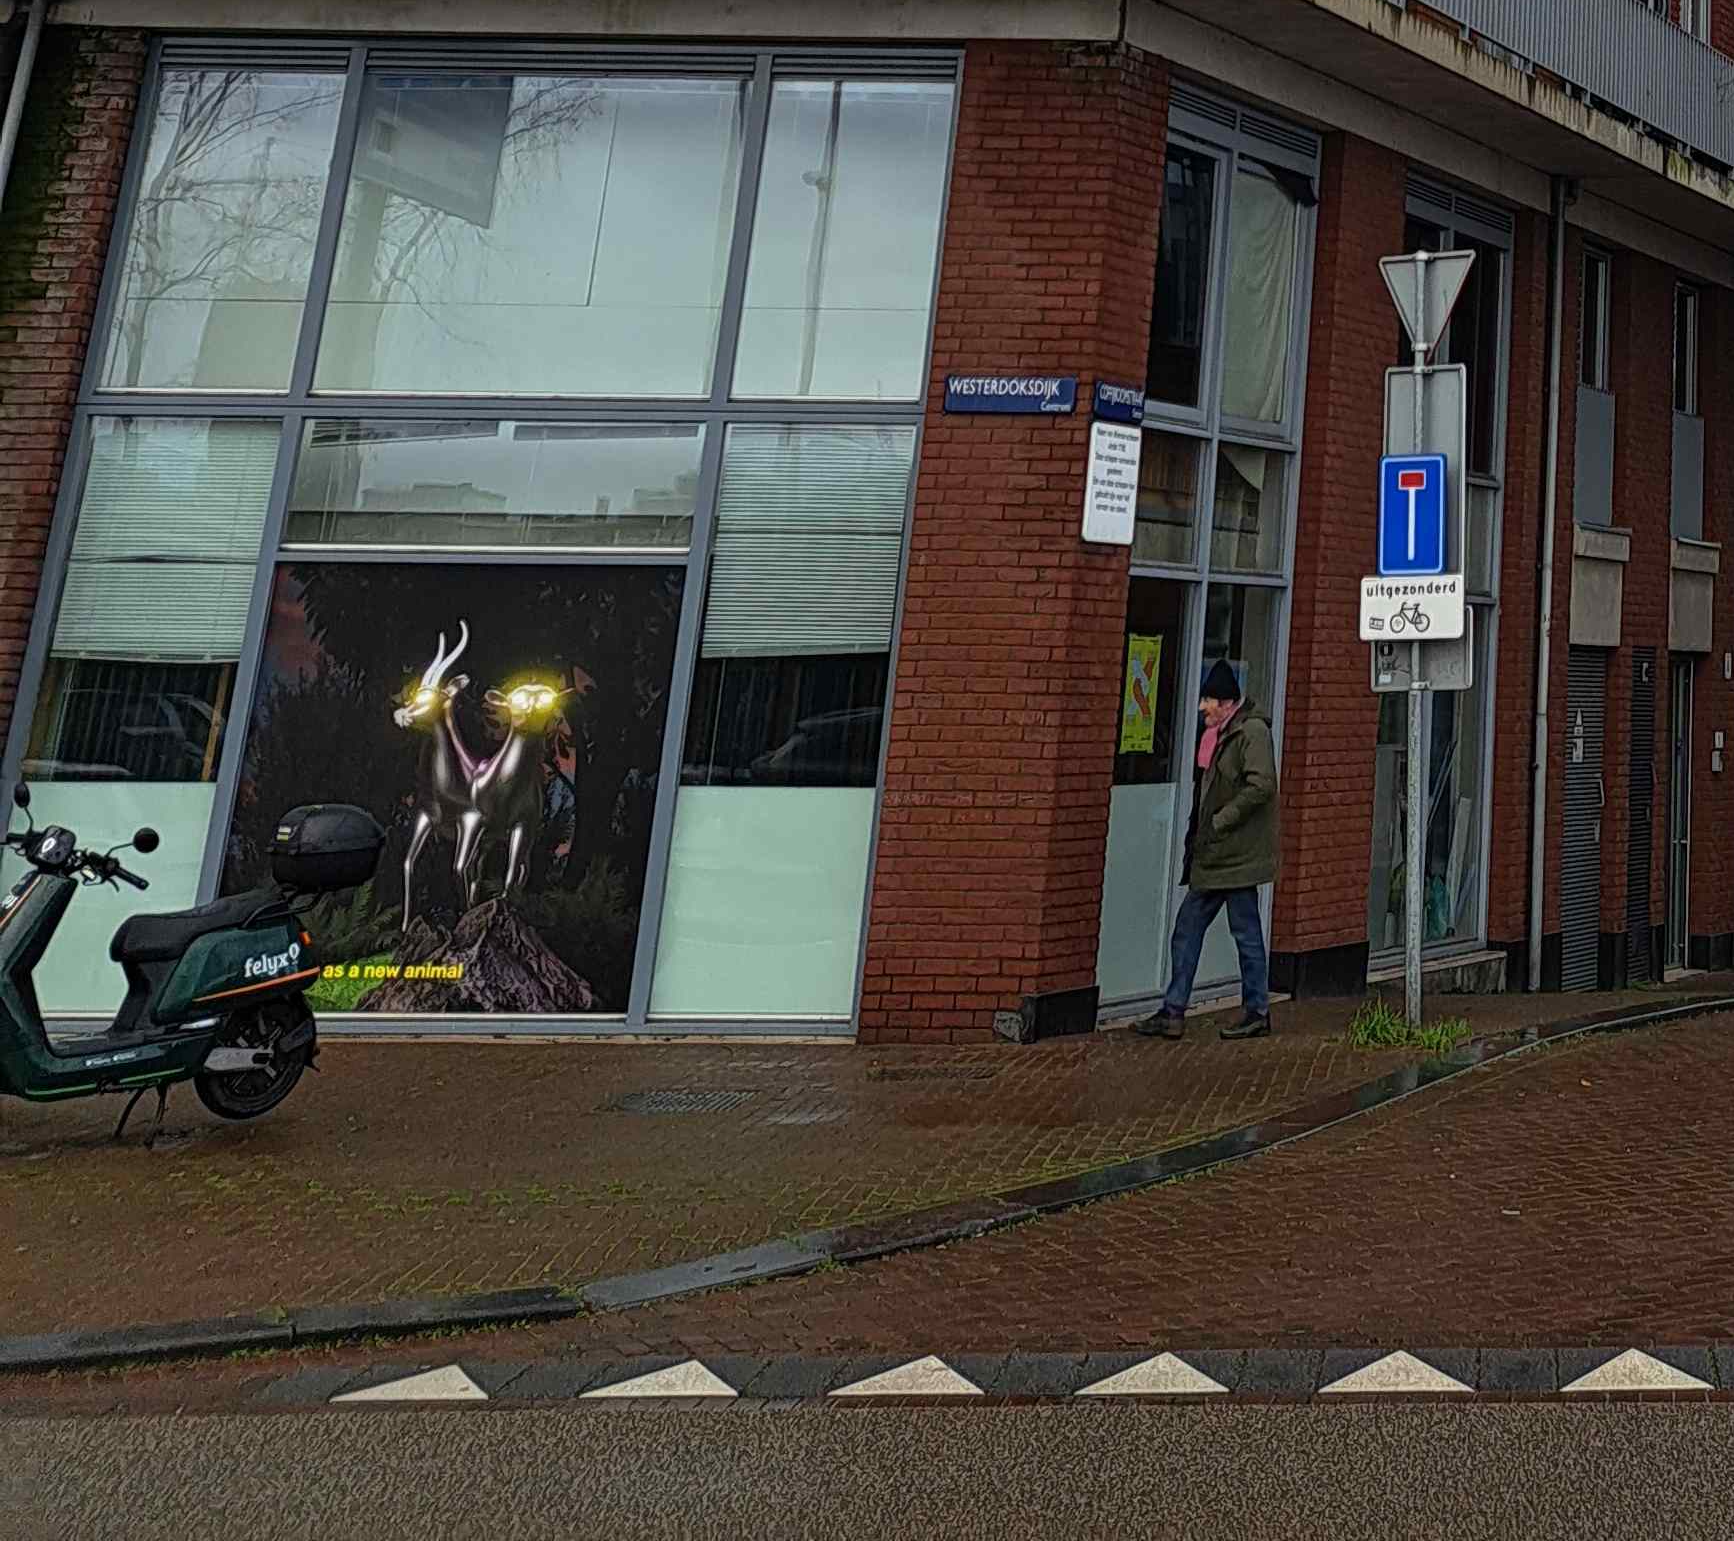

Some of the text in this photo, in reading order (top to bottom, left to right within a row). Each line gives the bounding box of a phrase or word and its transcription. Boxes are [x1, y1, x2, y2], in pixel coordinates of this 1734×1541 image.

[949, 378, 1061, 399] WESTERDOKSDIJK
[1366, 580, 1457, 599] uitgezonderd
[244, 952, 288, 978] felyx
[323, 962, 463, 979] as a new animal
